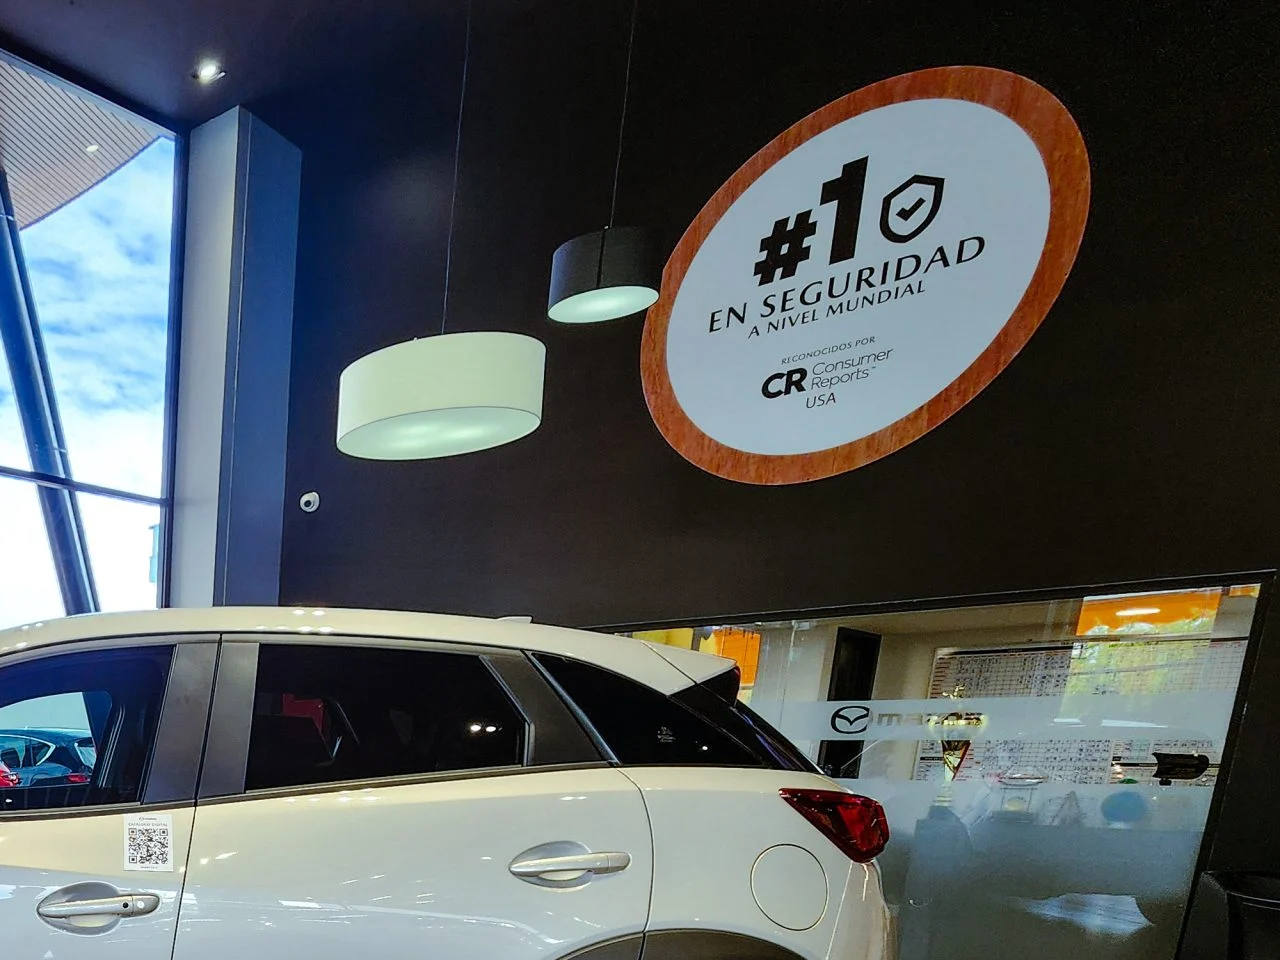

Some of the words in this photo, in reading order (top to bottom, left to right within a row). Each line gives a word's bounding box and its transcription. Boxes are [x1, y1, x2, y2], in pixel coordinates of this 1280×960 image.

[753, 155, 869, 287] #1
[708, 303, 748, 333] EN
[759, 235, 986, 318] SEGURIDAD
[748, 325, 760, 338] A
[766, 309, 820, 334] NIVEL
[825, 280, 926, 318] MUNDIAL
[780, 341, 852, 366] RECONOCIDOS
[854, 336, 876, 347] POR
[812, 348, 894, 376] Consumer
[761, 367, 808, 399] CR
[805, 392, 837, 409] USA
